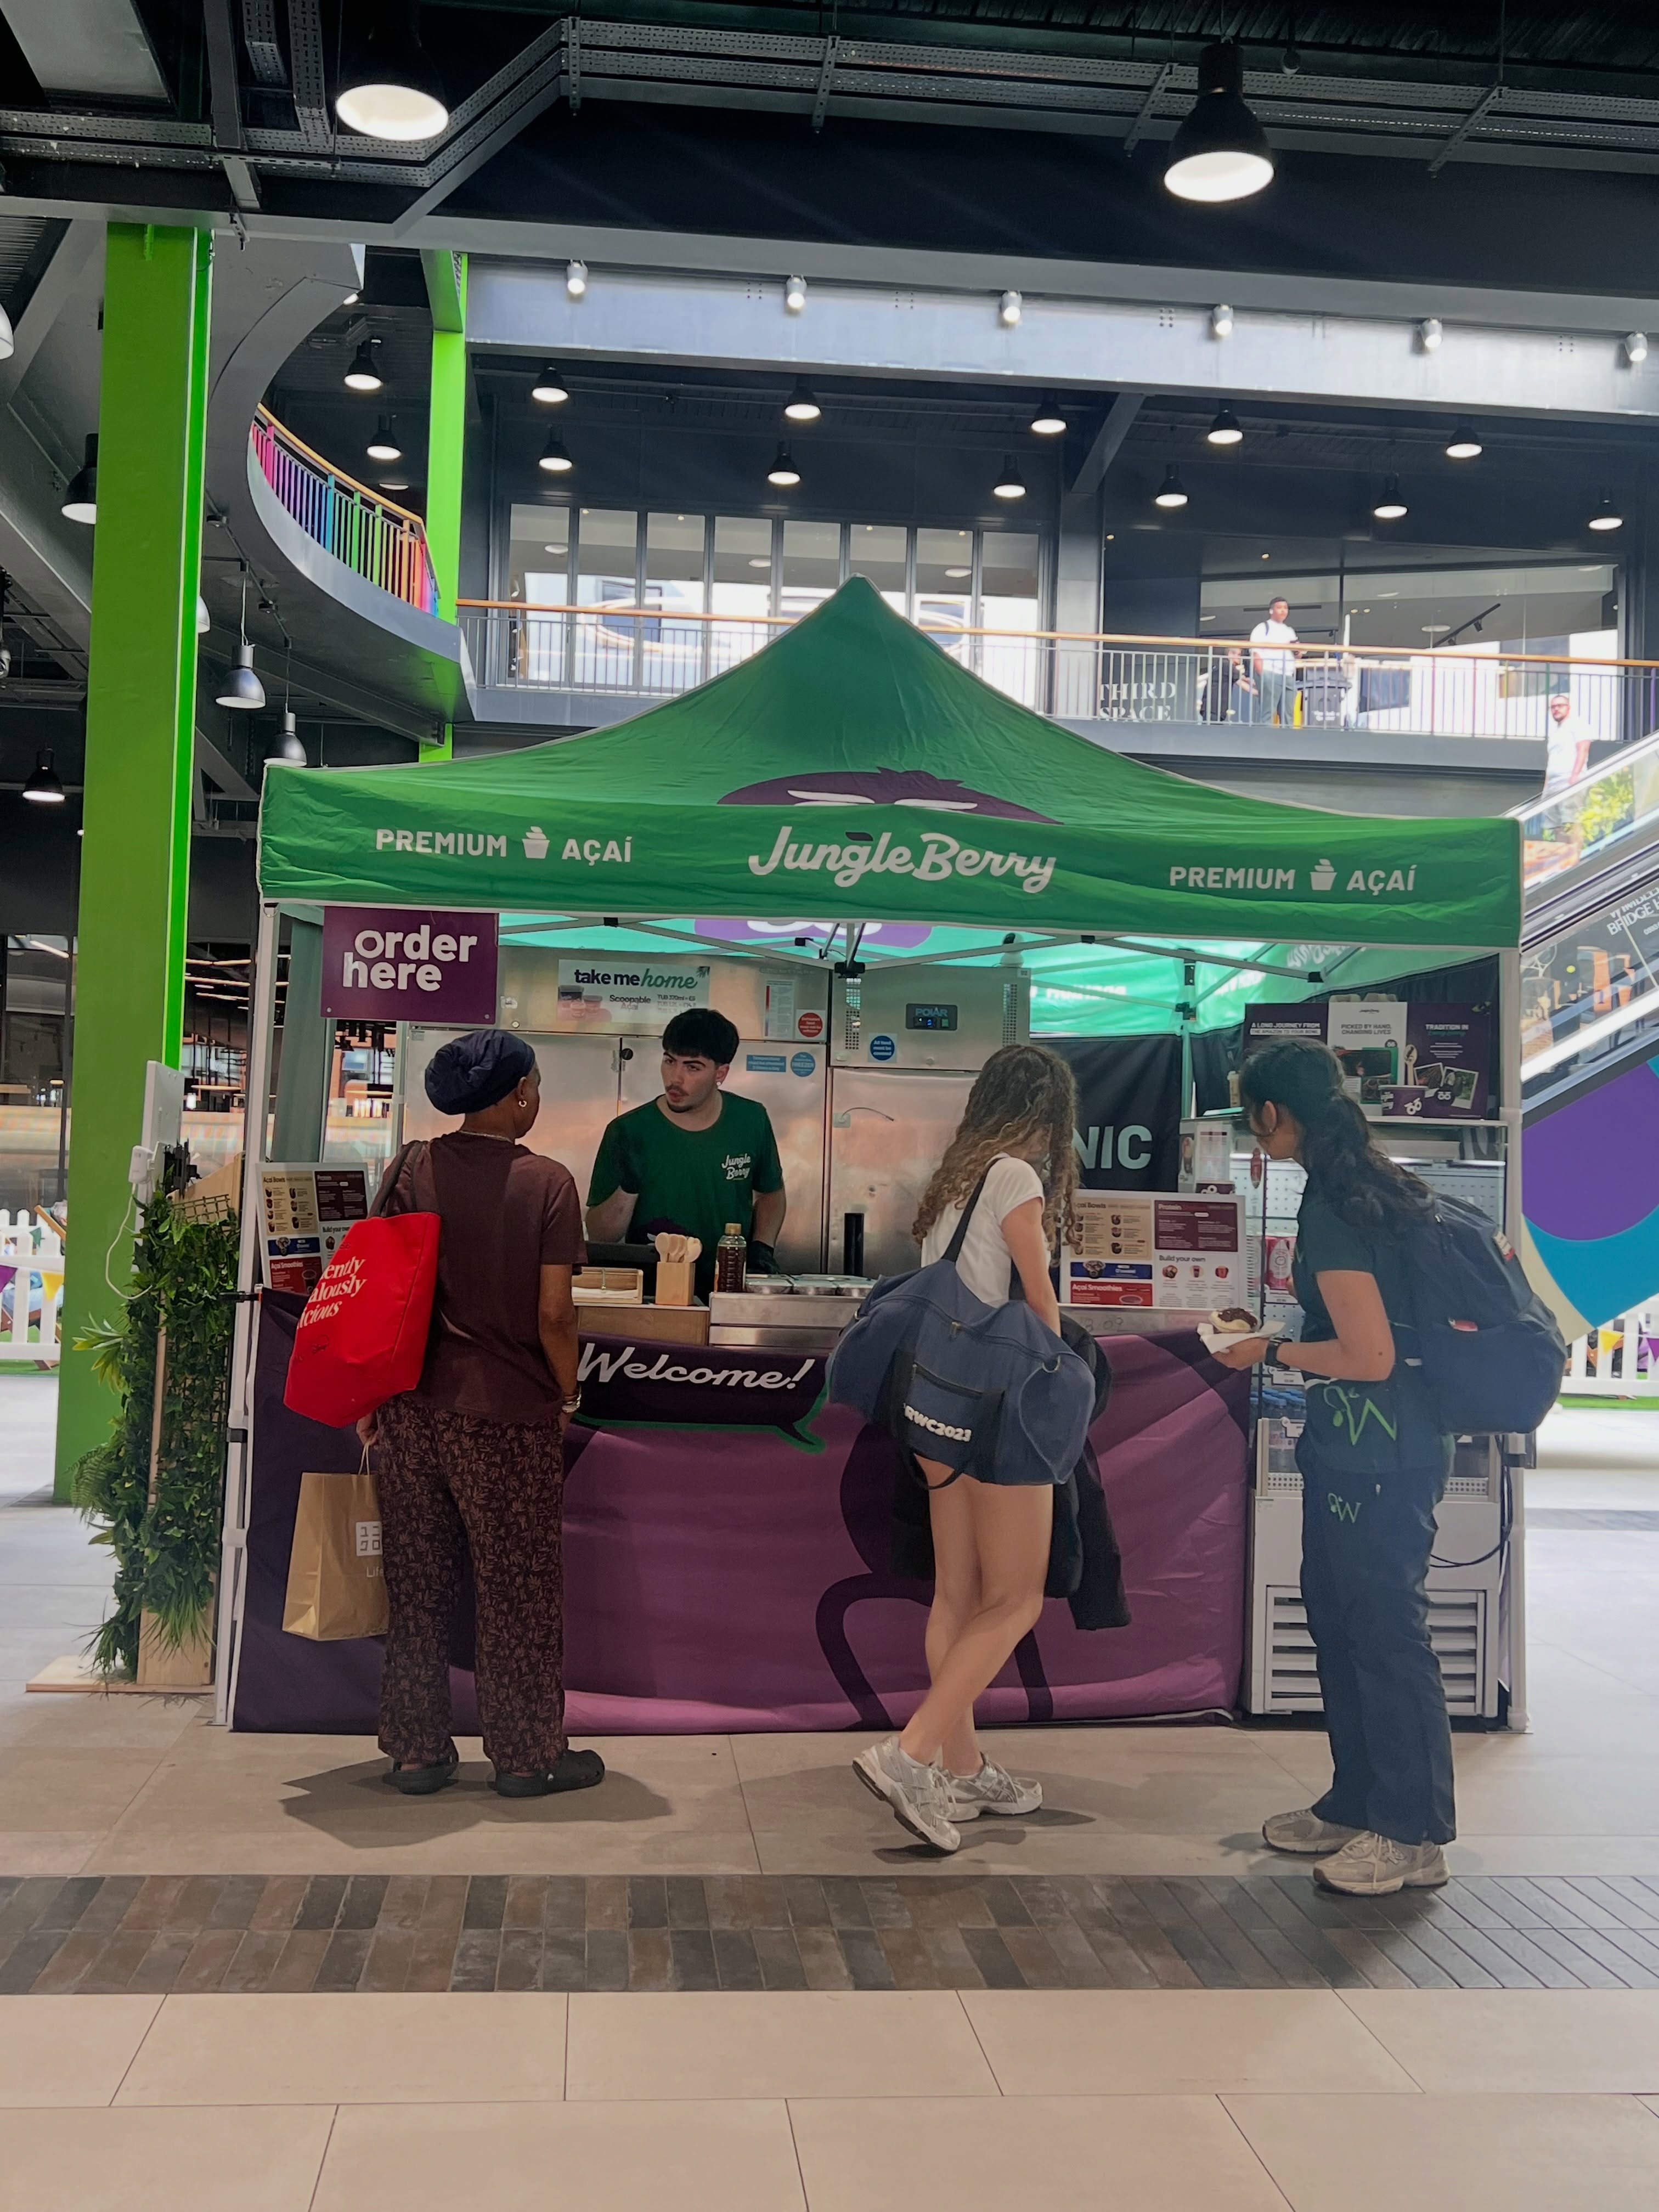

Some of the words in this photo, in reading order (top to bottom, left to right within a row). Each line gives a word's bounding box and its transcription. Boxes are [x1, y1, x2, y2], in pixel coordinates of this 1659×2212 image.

[1099, 682, 1176, 700] THIRD
[1099, 705, 1171, 722] SPACE
[376, 828, 507, 857] PREMIUM
[561, 836, 633, 866] AÇAÍ
[1169, 866, 1296, 890] PREMIUM
[1346, 865, 1418, 896] AÇAÍ
[1606, 902, 1655, 935] BRIDGE
[354, 924, 478, 962] order
[342, 951, 442, 991] here
[574, 969, 611, 984] take
[613, 974, 641, 986] me
[640, 968, 698, 989] home
[610, 994, 652, 1004] Scoopable
[721, 1153, 751, 1169] Jungle
[726, 1166, 751, 1180] Berry
[320, 1255, 366, 1280] ently
[297, 1301, 343, 1330] icious
[577, 1342, 815, 1390] Welcome!
[904, 1403, 972, 1442] RWC2023
